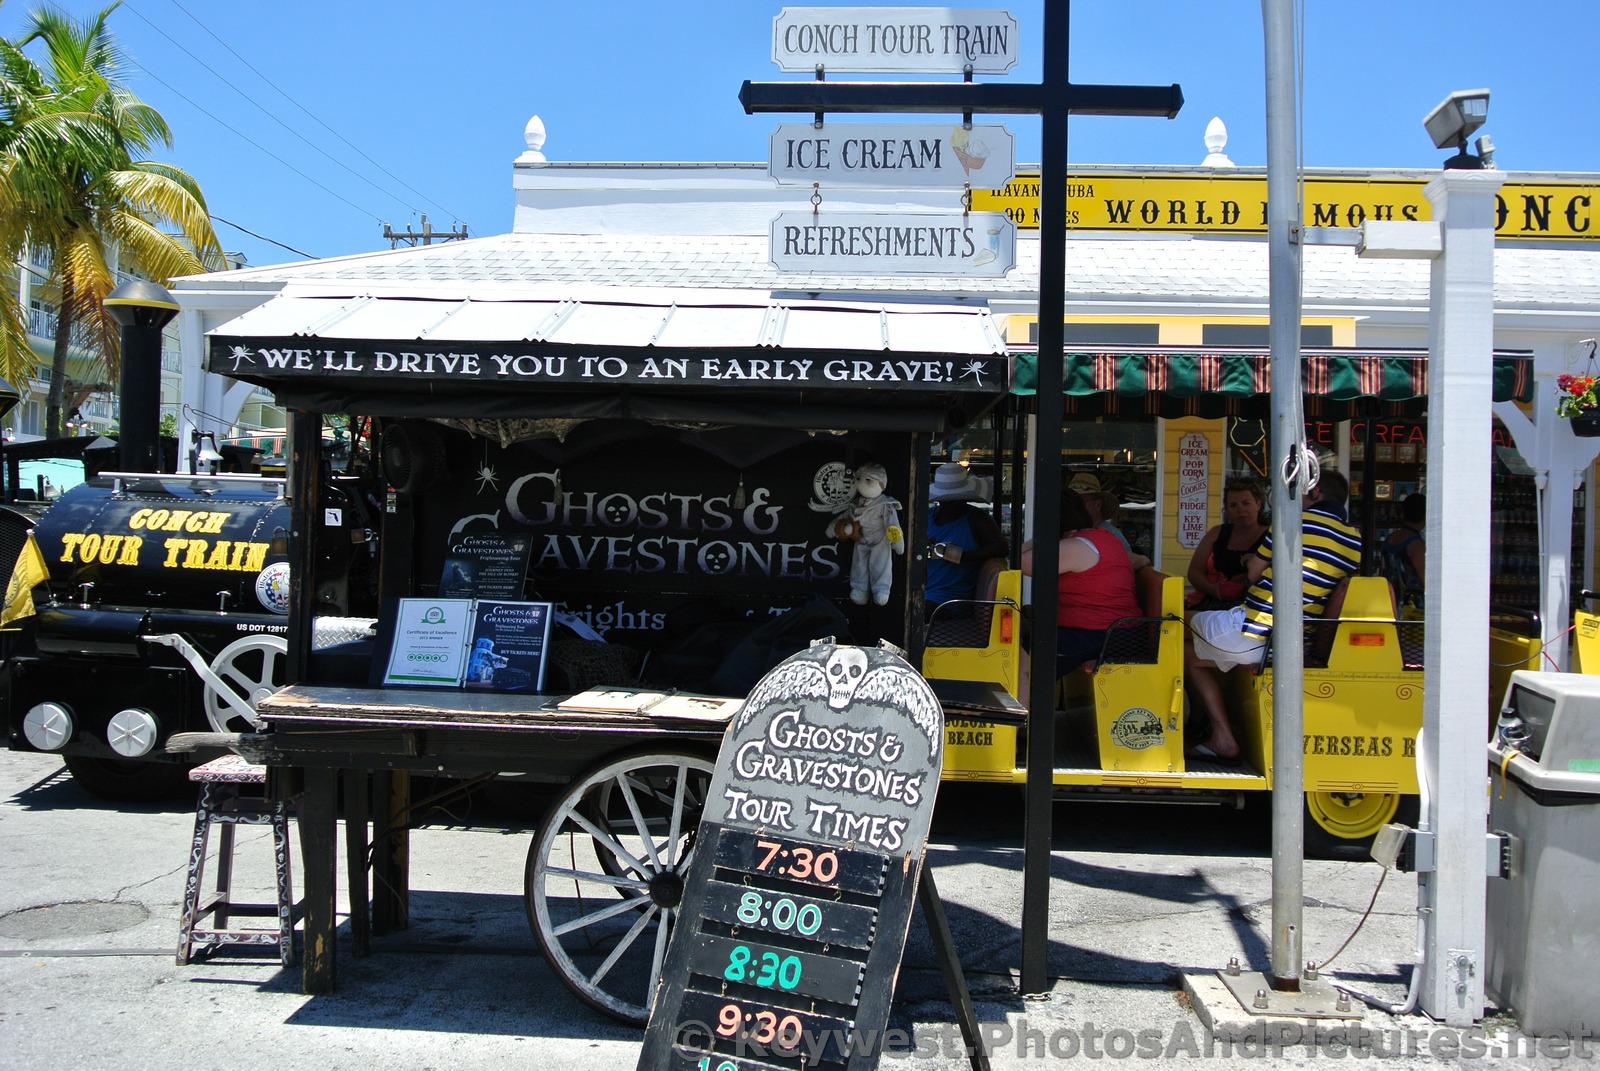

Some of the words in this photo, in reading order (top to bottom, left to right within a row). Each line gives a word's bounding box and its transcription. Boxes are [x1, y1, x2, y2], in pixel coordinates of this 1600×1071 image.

[784, 24, 858, 54] CONCH
[866, 24, 934, 54] TOUR
[940, 25, 1008, 61] TRAIN
[786, 138, 830, 170] ICE
[842, 138, 942, 170] CREAM
[1067, 184, 1094, 198] UBA
[1104, 199, 1241, 225] WORLD
[783, 225, 976, 259] REFRESHMENTS
[258, 348, 364, 372] WE'LL
[374, 351, 481, 375] DRIVE
[490, 354, 567, 378] YOU
[578, 356, 628, 378] TO
[638, 358, 689, 380] AN
[701, 358, 813, 381] EARLY
[823, 360, 954, 383] GRAVE!
[1351, 423, 1426, 444] CREA
[1180, 481, 1206, 496] COOKIES
[1182, 469, 1204, 478] CORN
[505, 468, 732, 531] GHOSTS
[742, 487, 784, 534] &
[1180, 502, 1206, 510] FUDGE
[128, 508, 231, 534] CONCH
[1186, 532, 1200, 540] PIE
[60, 533, 144, 566] TOUR
[163, 537, 270, 572] TRAIN
[448, 510, 840, 580] AVESTONES
[483, 614, 538, 624] GRAVESTONES
[493, 606, 525, 616] GHOSTS
[769, 710, 878, 757] GHOSTS
[880, 735, 902, 762] &
[948, 731, 994, 746] BEACH
[735, 738, 922, 806] GRAVESTONES
[724, 788, 800, 830] TOUR
[809, 801, 907, 850] TIMES
[756, 840, 839, 883] 7:30
[736, 892, 823, 936] 8:00
[724, 946, 802, 990] 8:30
[716, 1004, 803, 1050] 9:30
